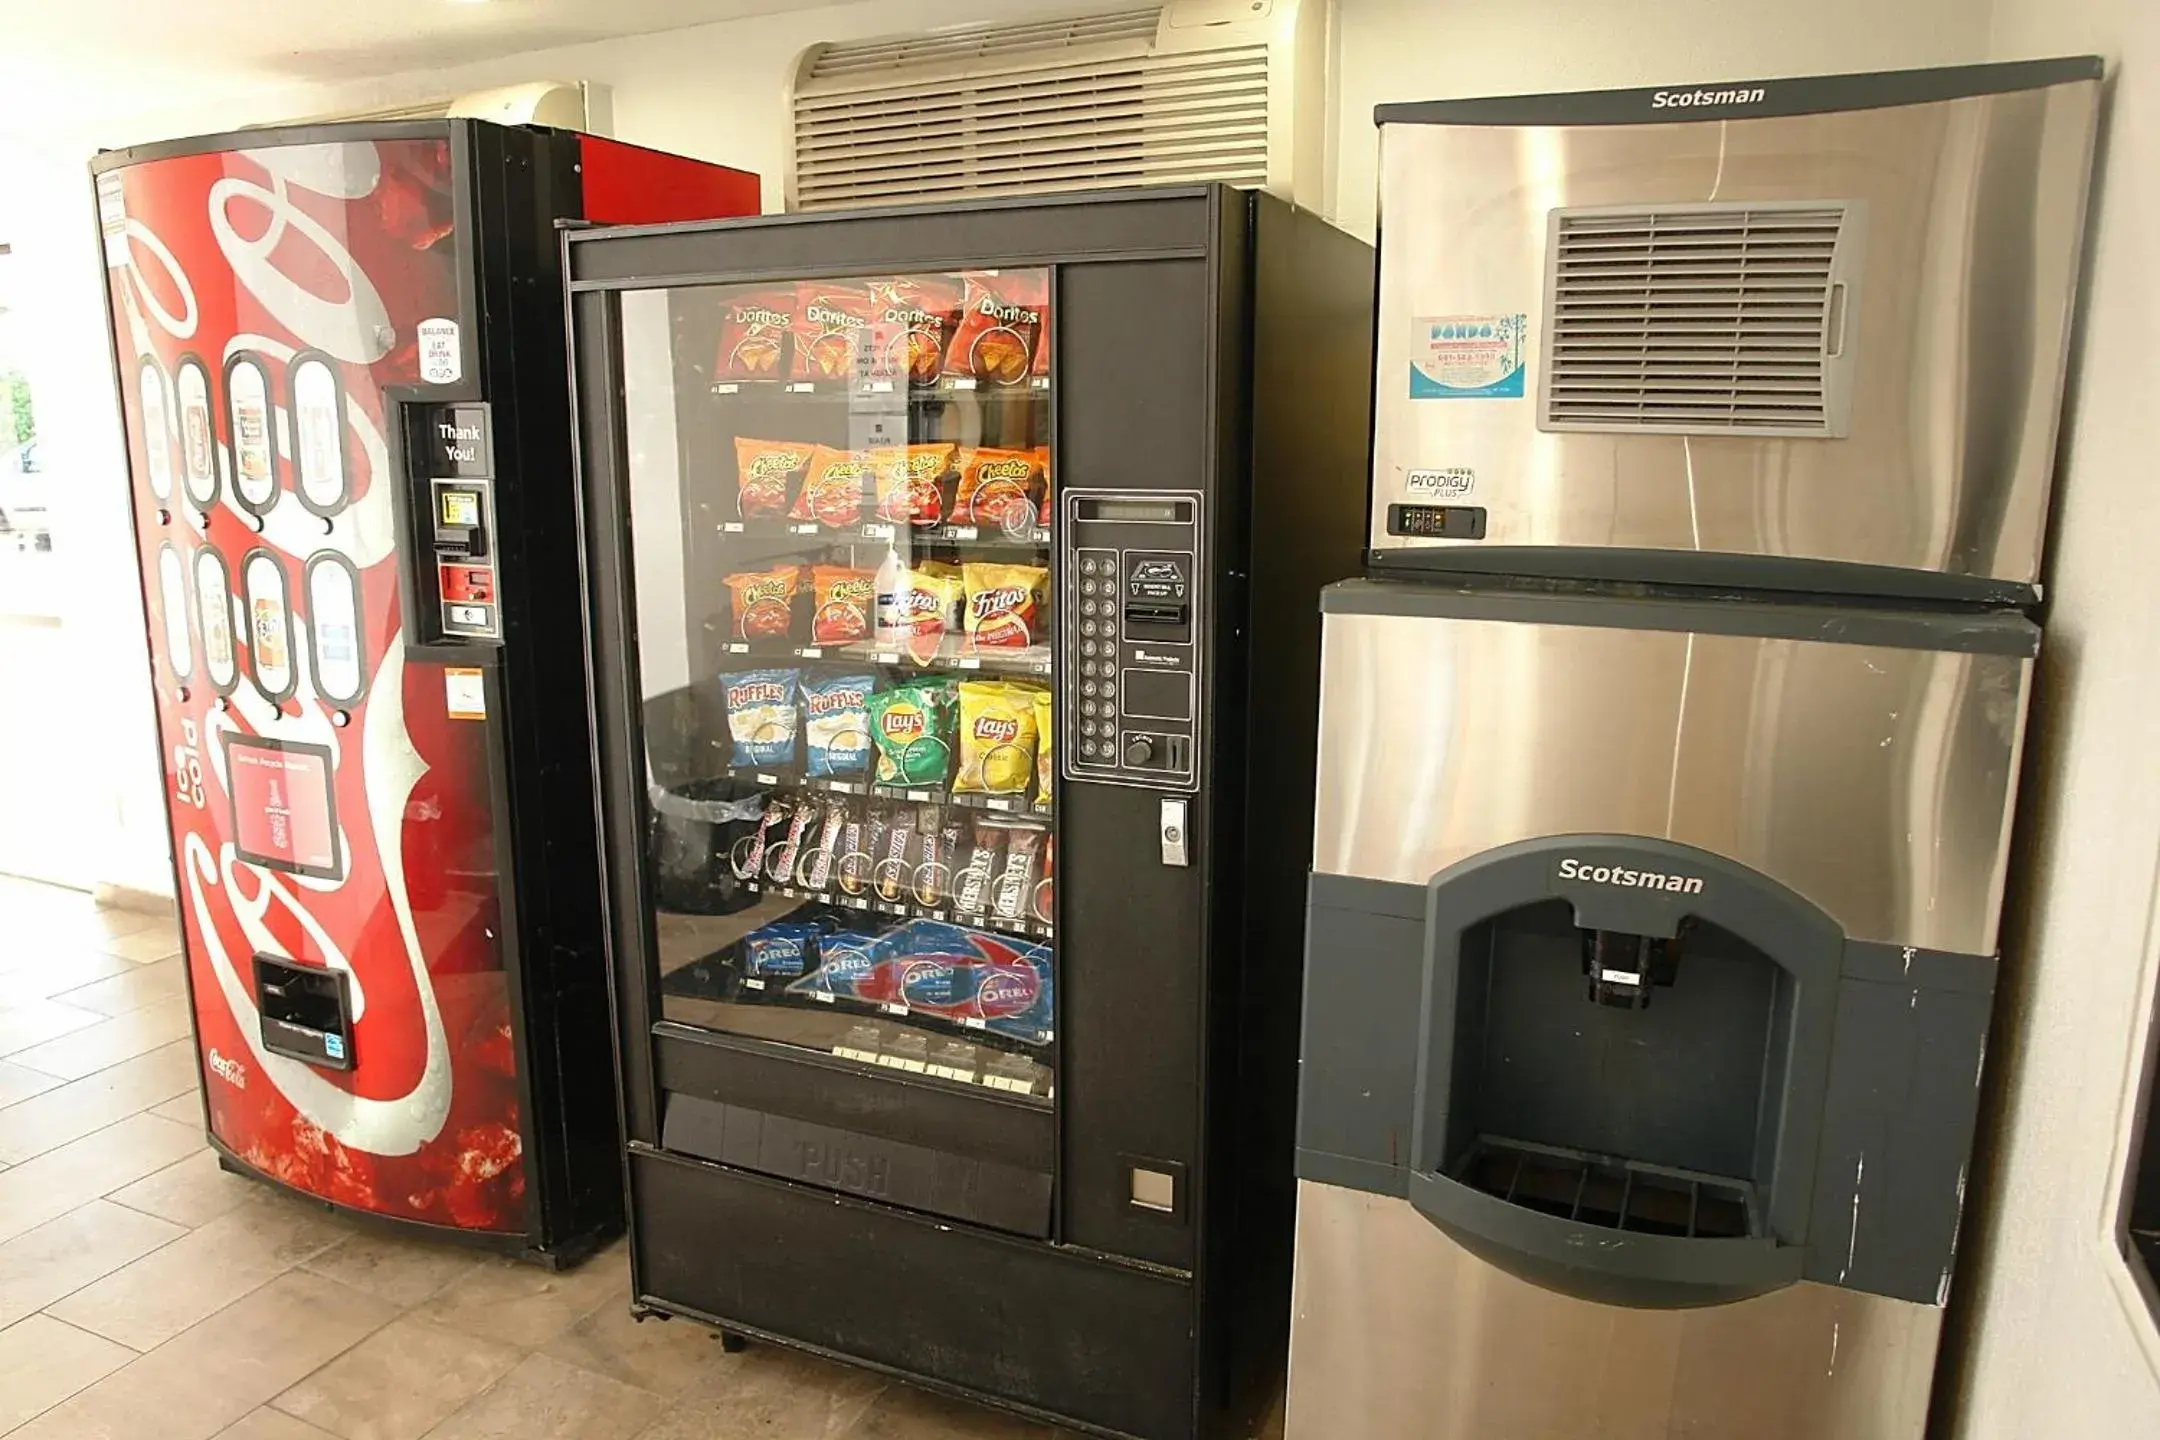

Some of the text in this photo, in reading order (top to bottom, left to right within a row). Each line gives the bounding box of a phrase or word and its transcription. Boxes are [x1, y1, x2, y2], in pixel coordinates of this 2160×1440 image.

[1652, 88, 1765, 108] Scotsman
[736, 309, 790, 325] Doritos
[807, 305, 865, 328] Doritos
[885, 309, 943, 328] Doritos
[981, 298, 1039, 324] Doritos
[438, 424, 481, 441] Thank
[446, 446, 476, 462] You!
[751, 455, 798, 477] Cheetos
[977, 461, 1029, 482] Cheetos
[1434, 489, 1458, 498] PLUS
[744, 580, 786, 605] Cheetos
[970, 586, 1027, 616] Fritos
[728, 684, 783, 708] RUFFLES
[810, 691, 864, 714] RUFFLES
[181, 718, 206, 809] cold
[1558, 858, 1704, 894] Scotsman
[826, 958, 872, 974] OREO
